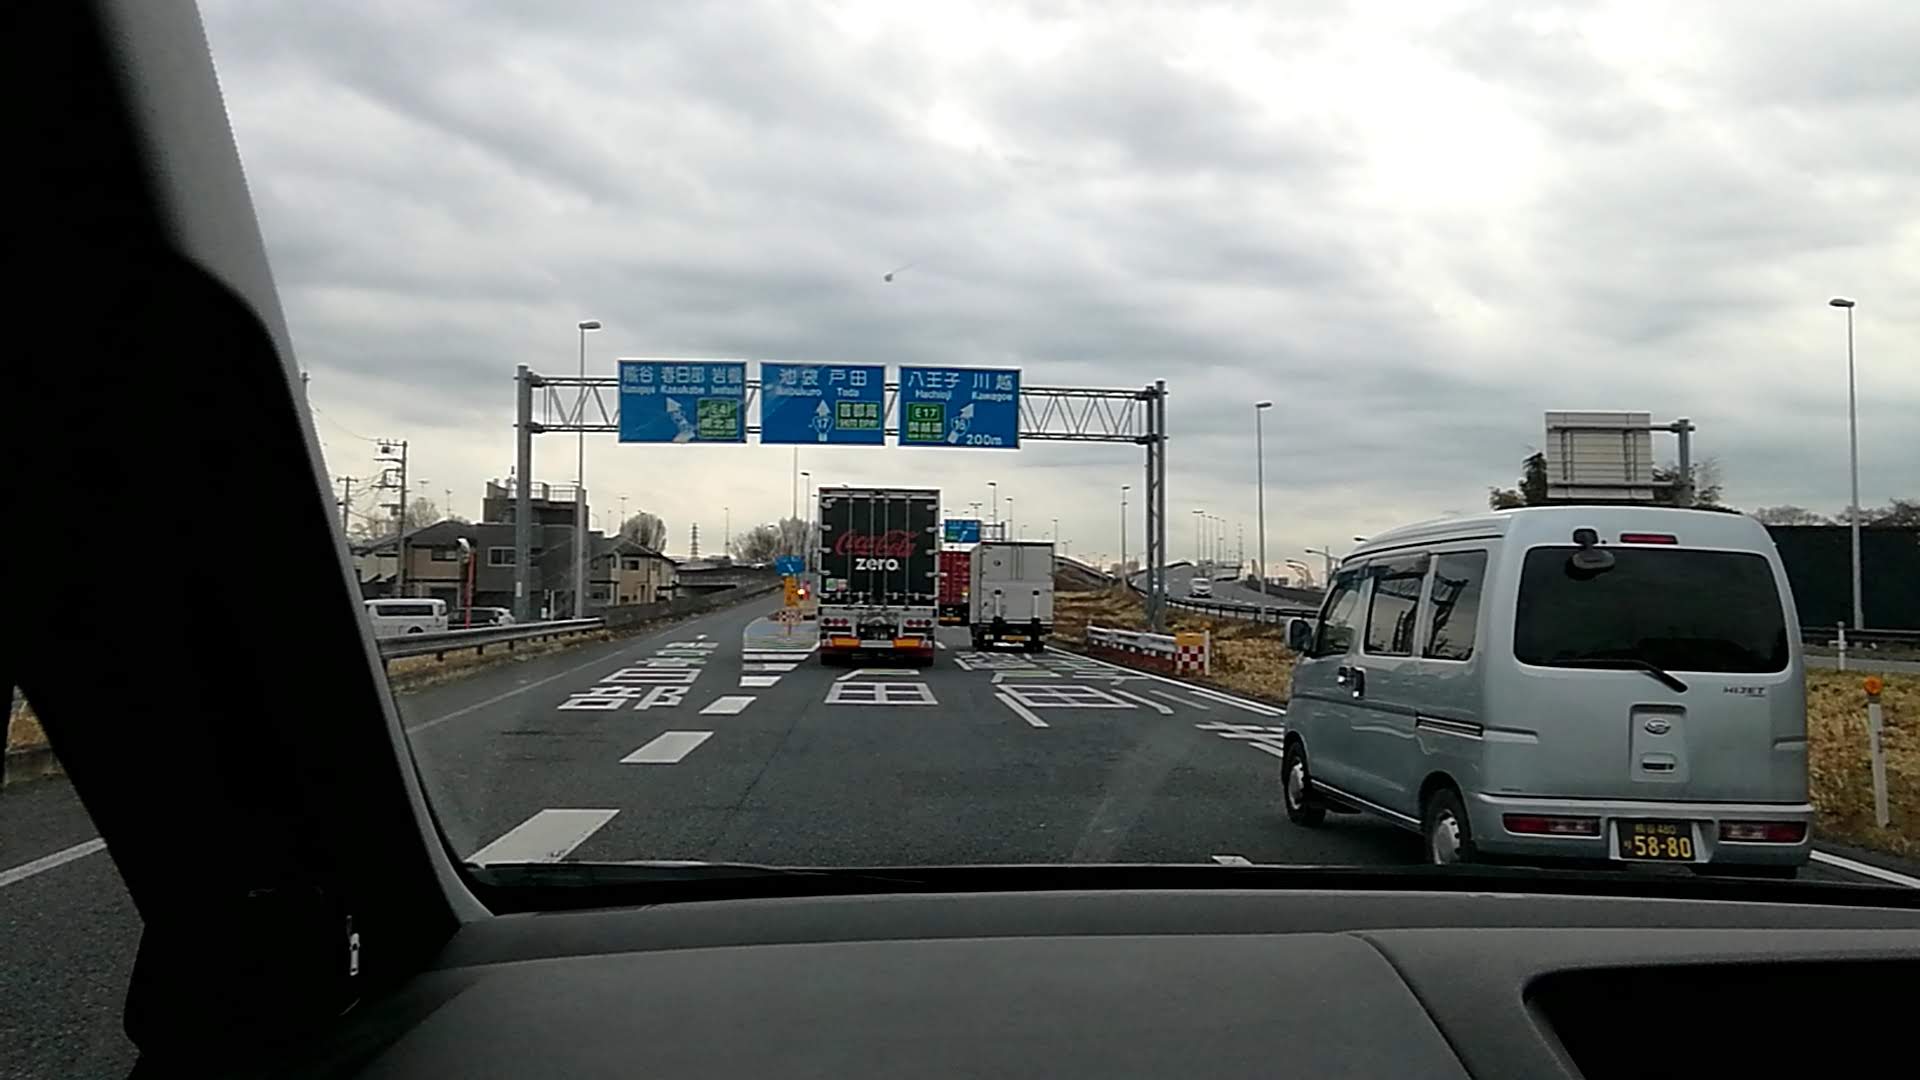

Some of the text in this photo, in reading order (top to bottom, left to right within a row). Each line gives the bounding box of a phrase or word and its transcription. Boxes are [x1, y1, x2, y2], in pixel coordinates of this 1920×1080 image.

[828, 368, 867, 387] 戸田
[907, 370, 1013, 391] 八王子 川越
[914, 407, 937, 418] E17
[966, 433, 1003, 446] 200m
[855, 557, 899, 571] zero
[1634, 835, 1692, 858] 58-80
